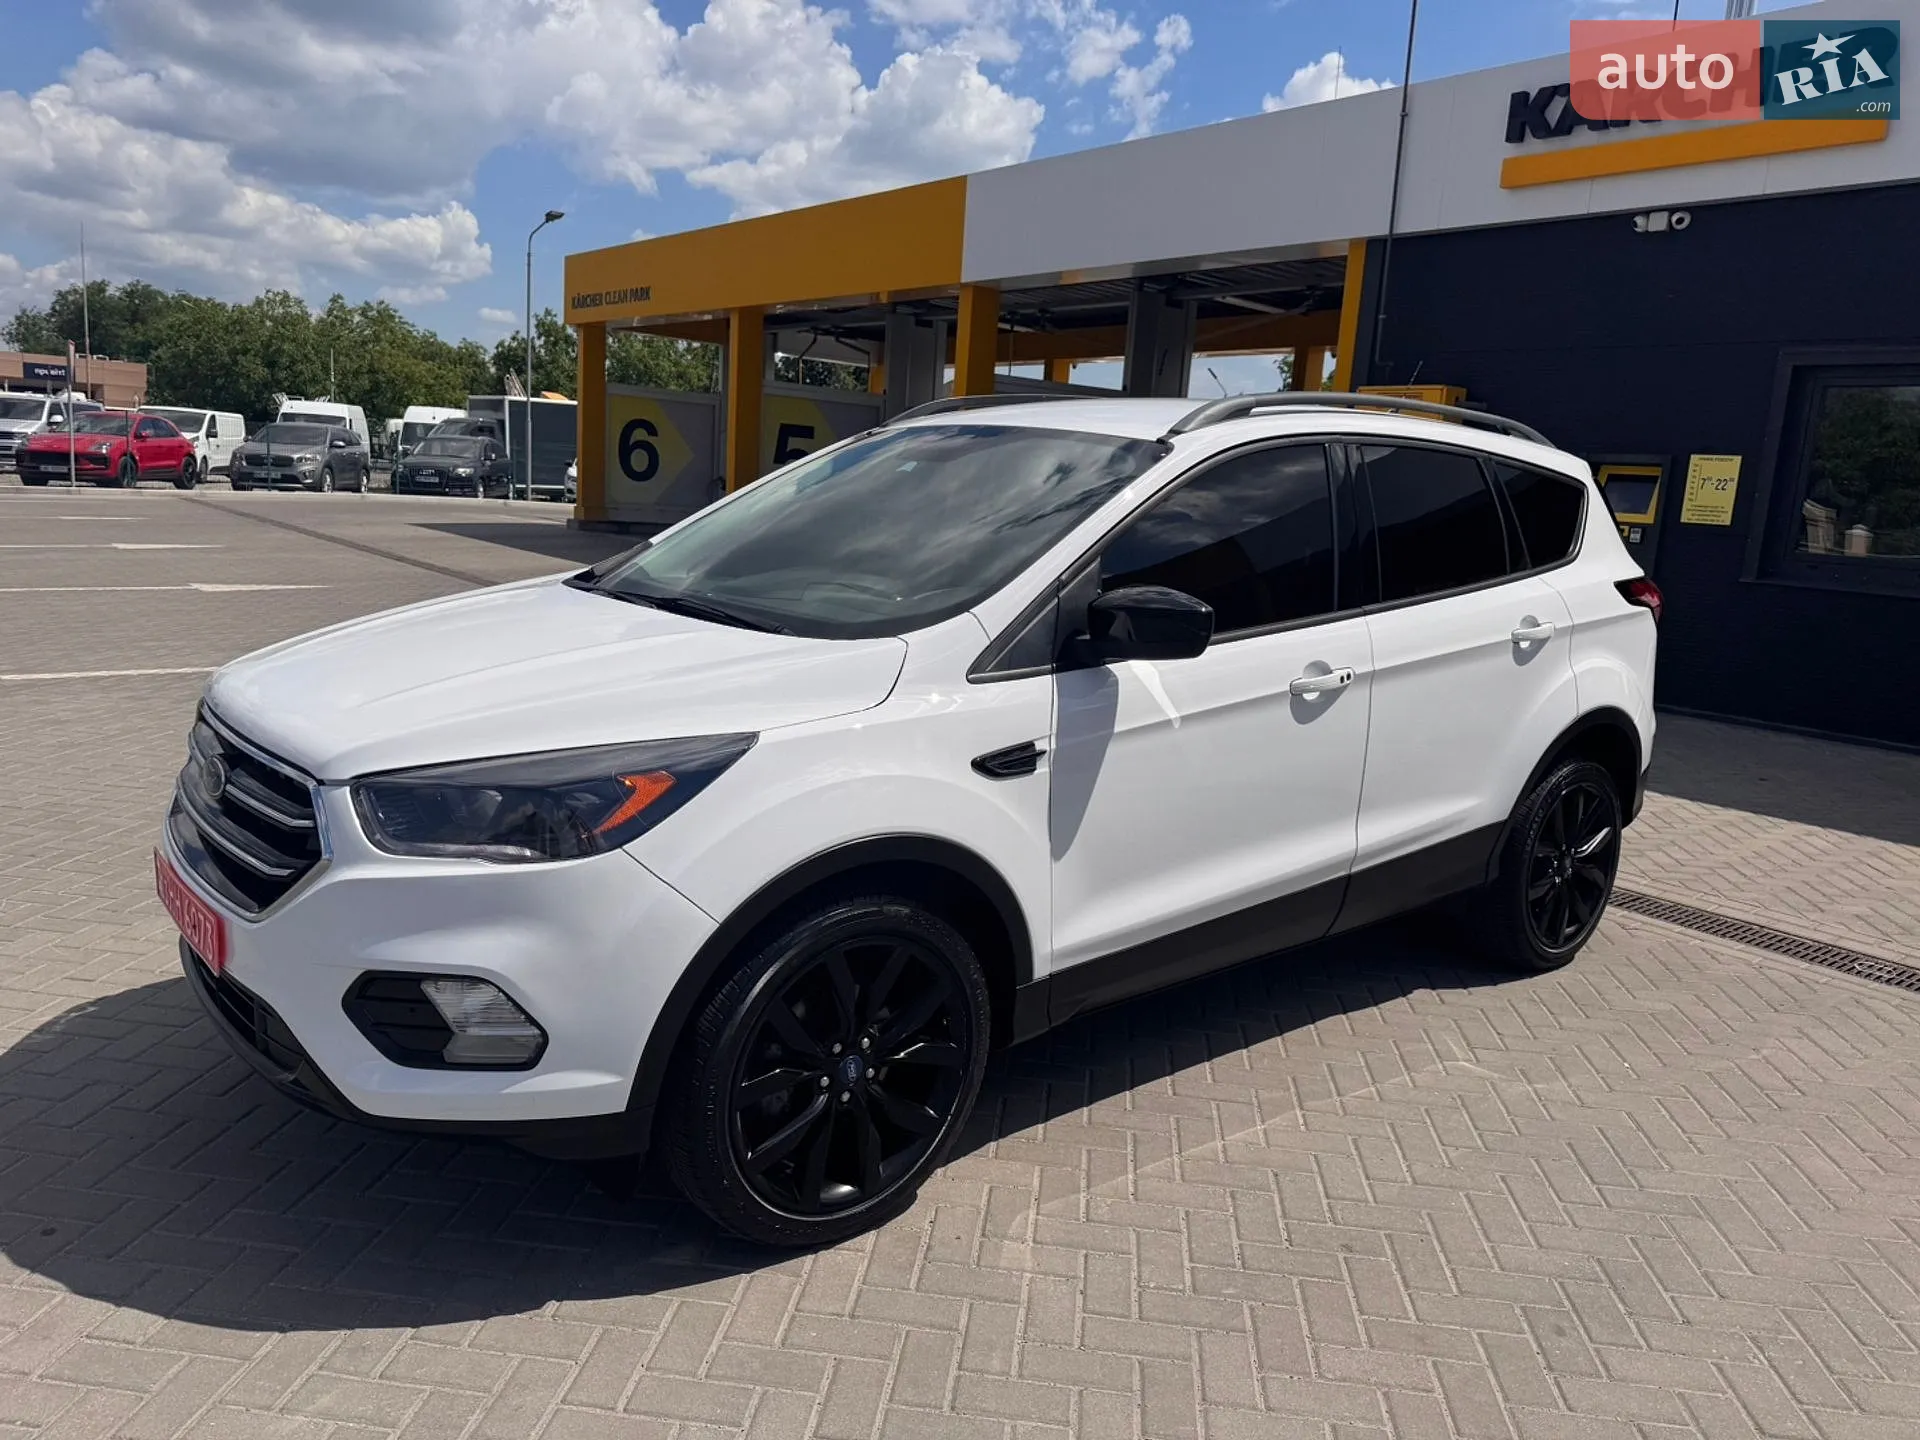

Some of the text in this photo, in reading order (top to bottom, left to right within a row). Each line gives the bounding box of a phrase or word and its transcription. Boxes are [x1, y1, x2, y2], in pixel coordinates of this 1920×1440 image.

[604, 288, 628, 305] CLEAN
[629, 285, 652, 303] PARK
[618, 418, 660, 482] 6
[773, 423, 815, 464] 5
